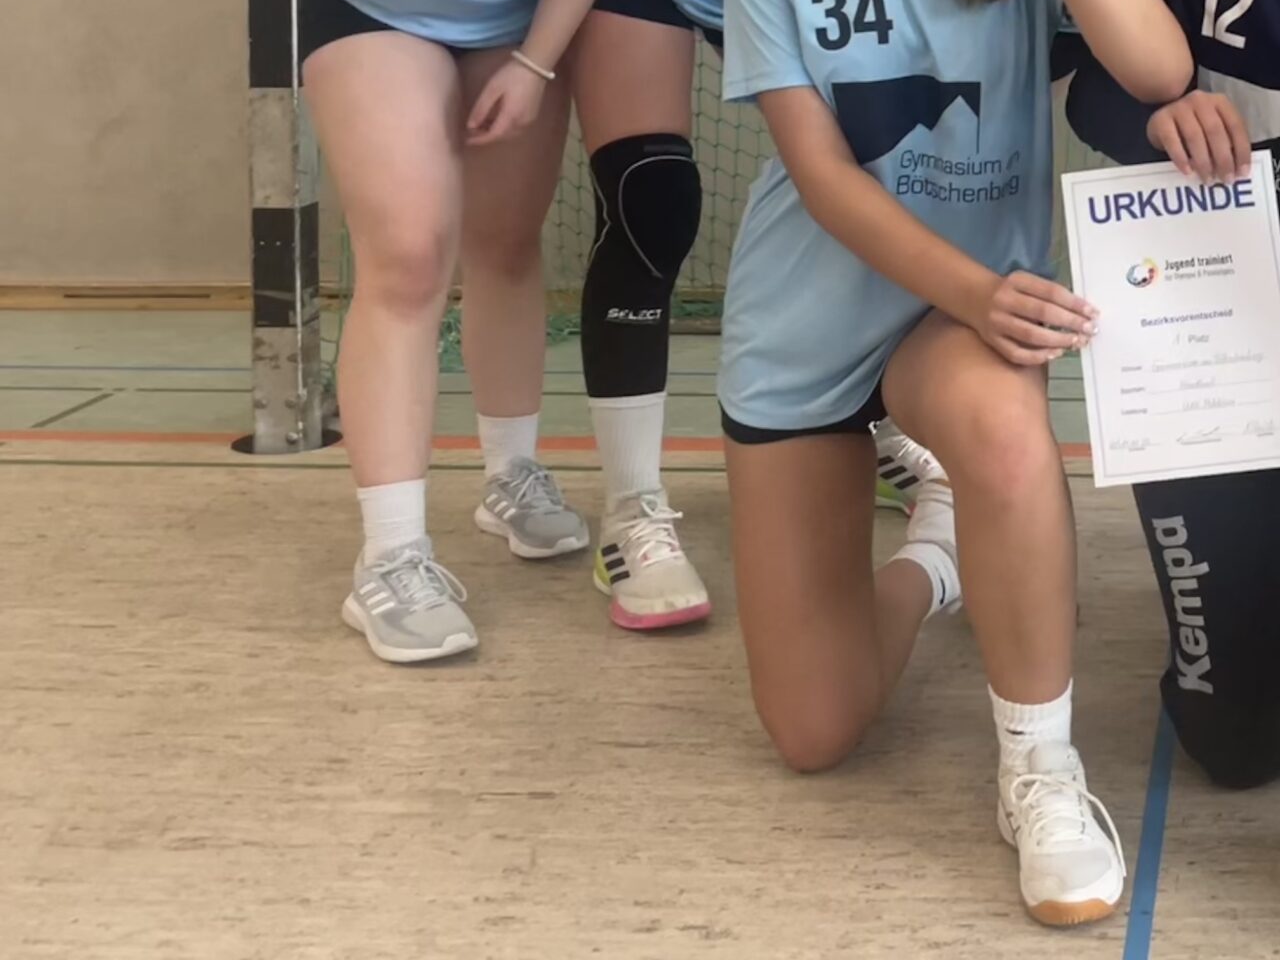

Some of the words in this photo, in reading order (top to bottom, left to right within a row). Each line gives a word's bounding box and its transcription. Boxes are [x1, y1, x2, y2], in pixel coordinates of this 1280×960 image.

[1088, 178, 1257, 225] URKUNDE
[1164, 256, 1196, 272] Jugend
[1196, 253, 1234, 267] trainiert
[606, 306, 662, 321] SELECT
[1151, 515, 1215, 695] Kempa
